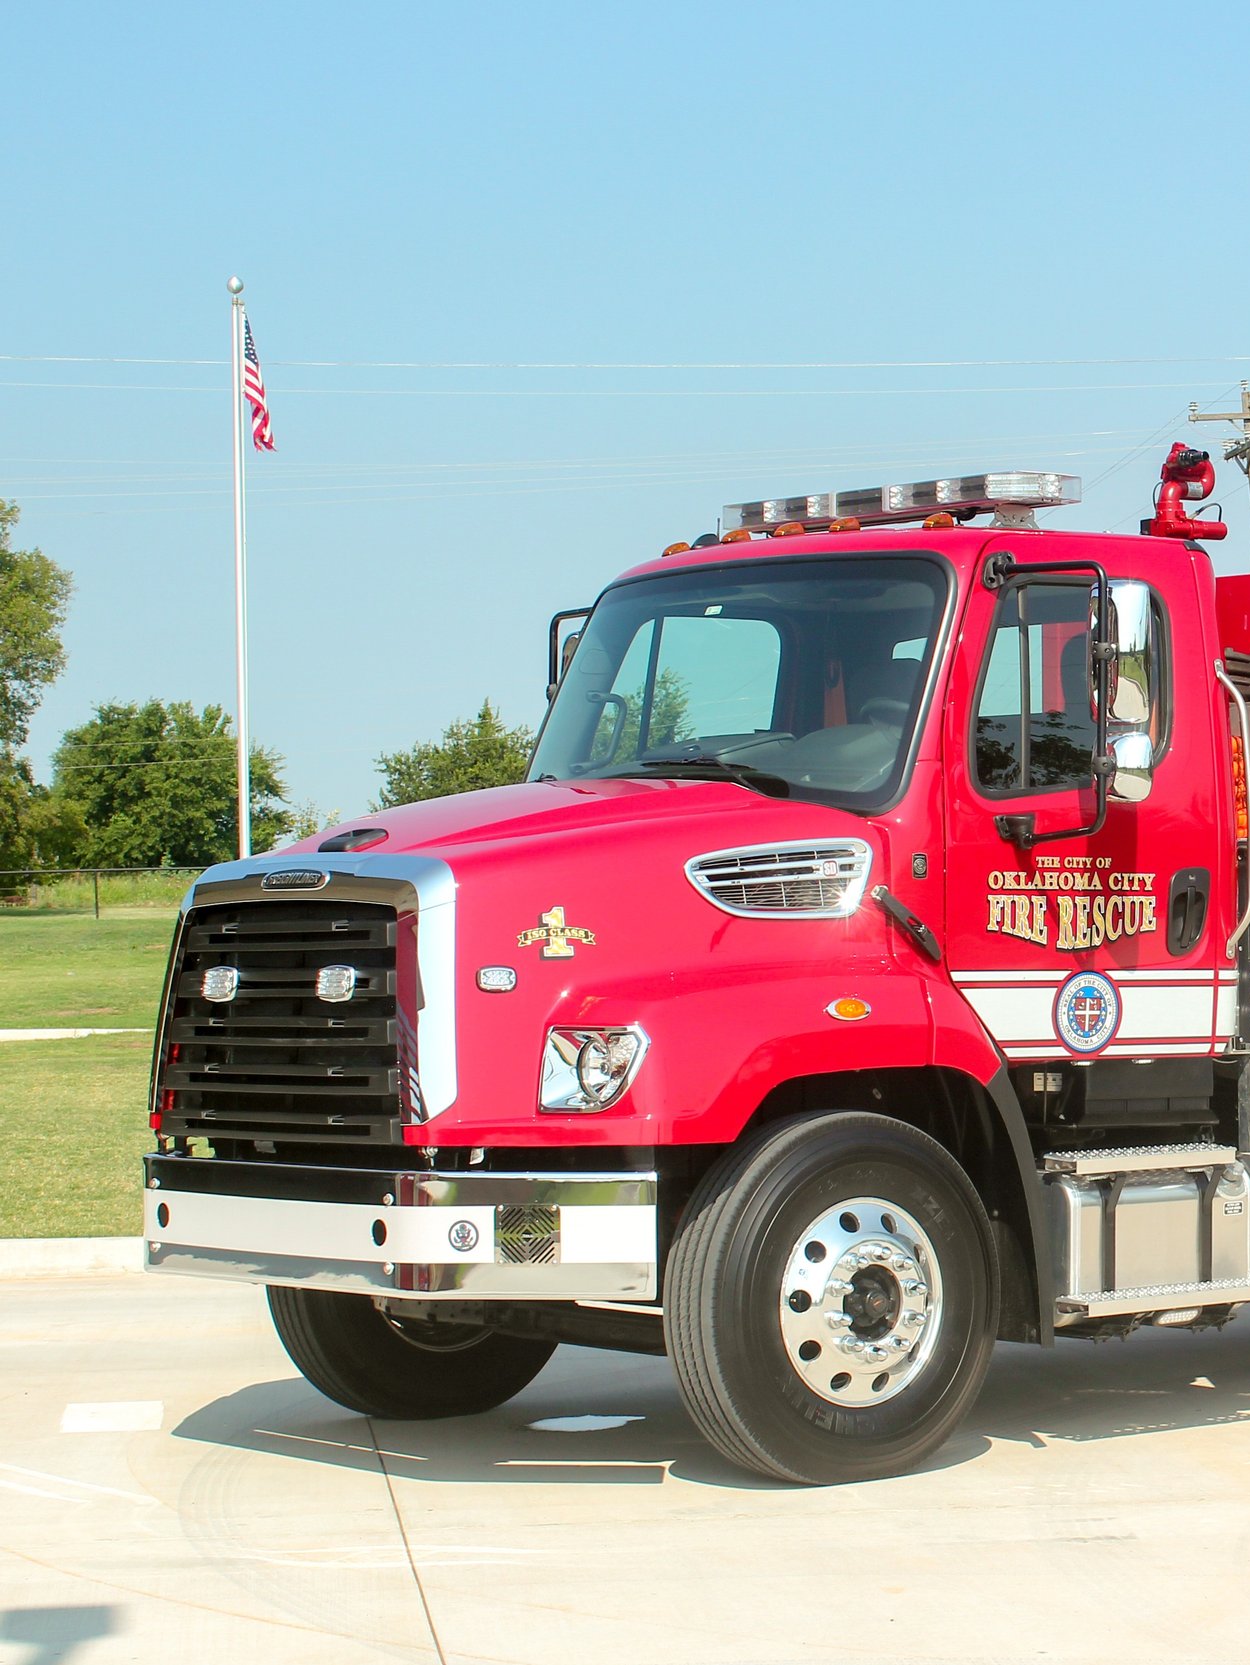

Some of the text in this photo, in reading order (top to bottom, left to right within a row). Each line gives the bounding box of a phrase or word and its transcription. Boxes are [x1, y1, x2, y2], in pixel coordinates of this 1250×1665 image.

[1036, 856, 1112, 869] THE CITY OF
[987, 871, 1156, 891] OKLAHOMA CITY
[540, 906, 575, 958] 1
[987, 895, 1156, 950] FIRE RESCUE
[526, 927, 586, 939] ISO CLASS
[1064, 1024, 1094, 1044] OKLAHOMA
